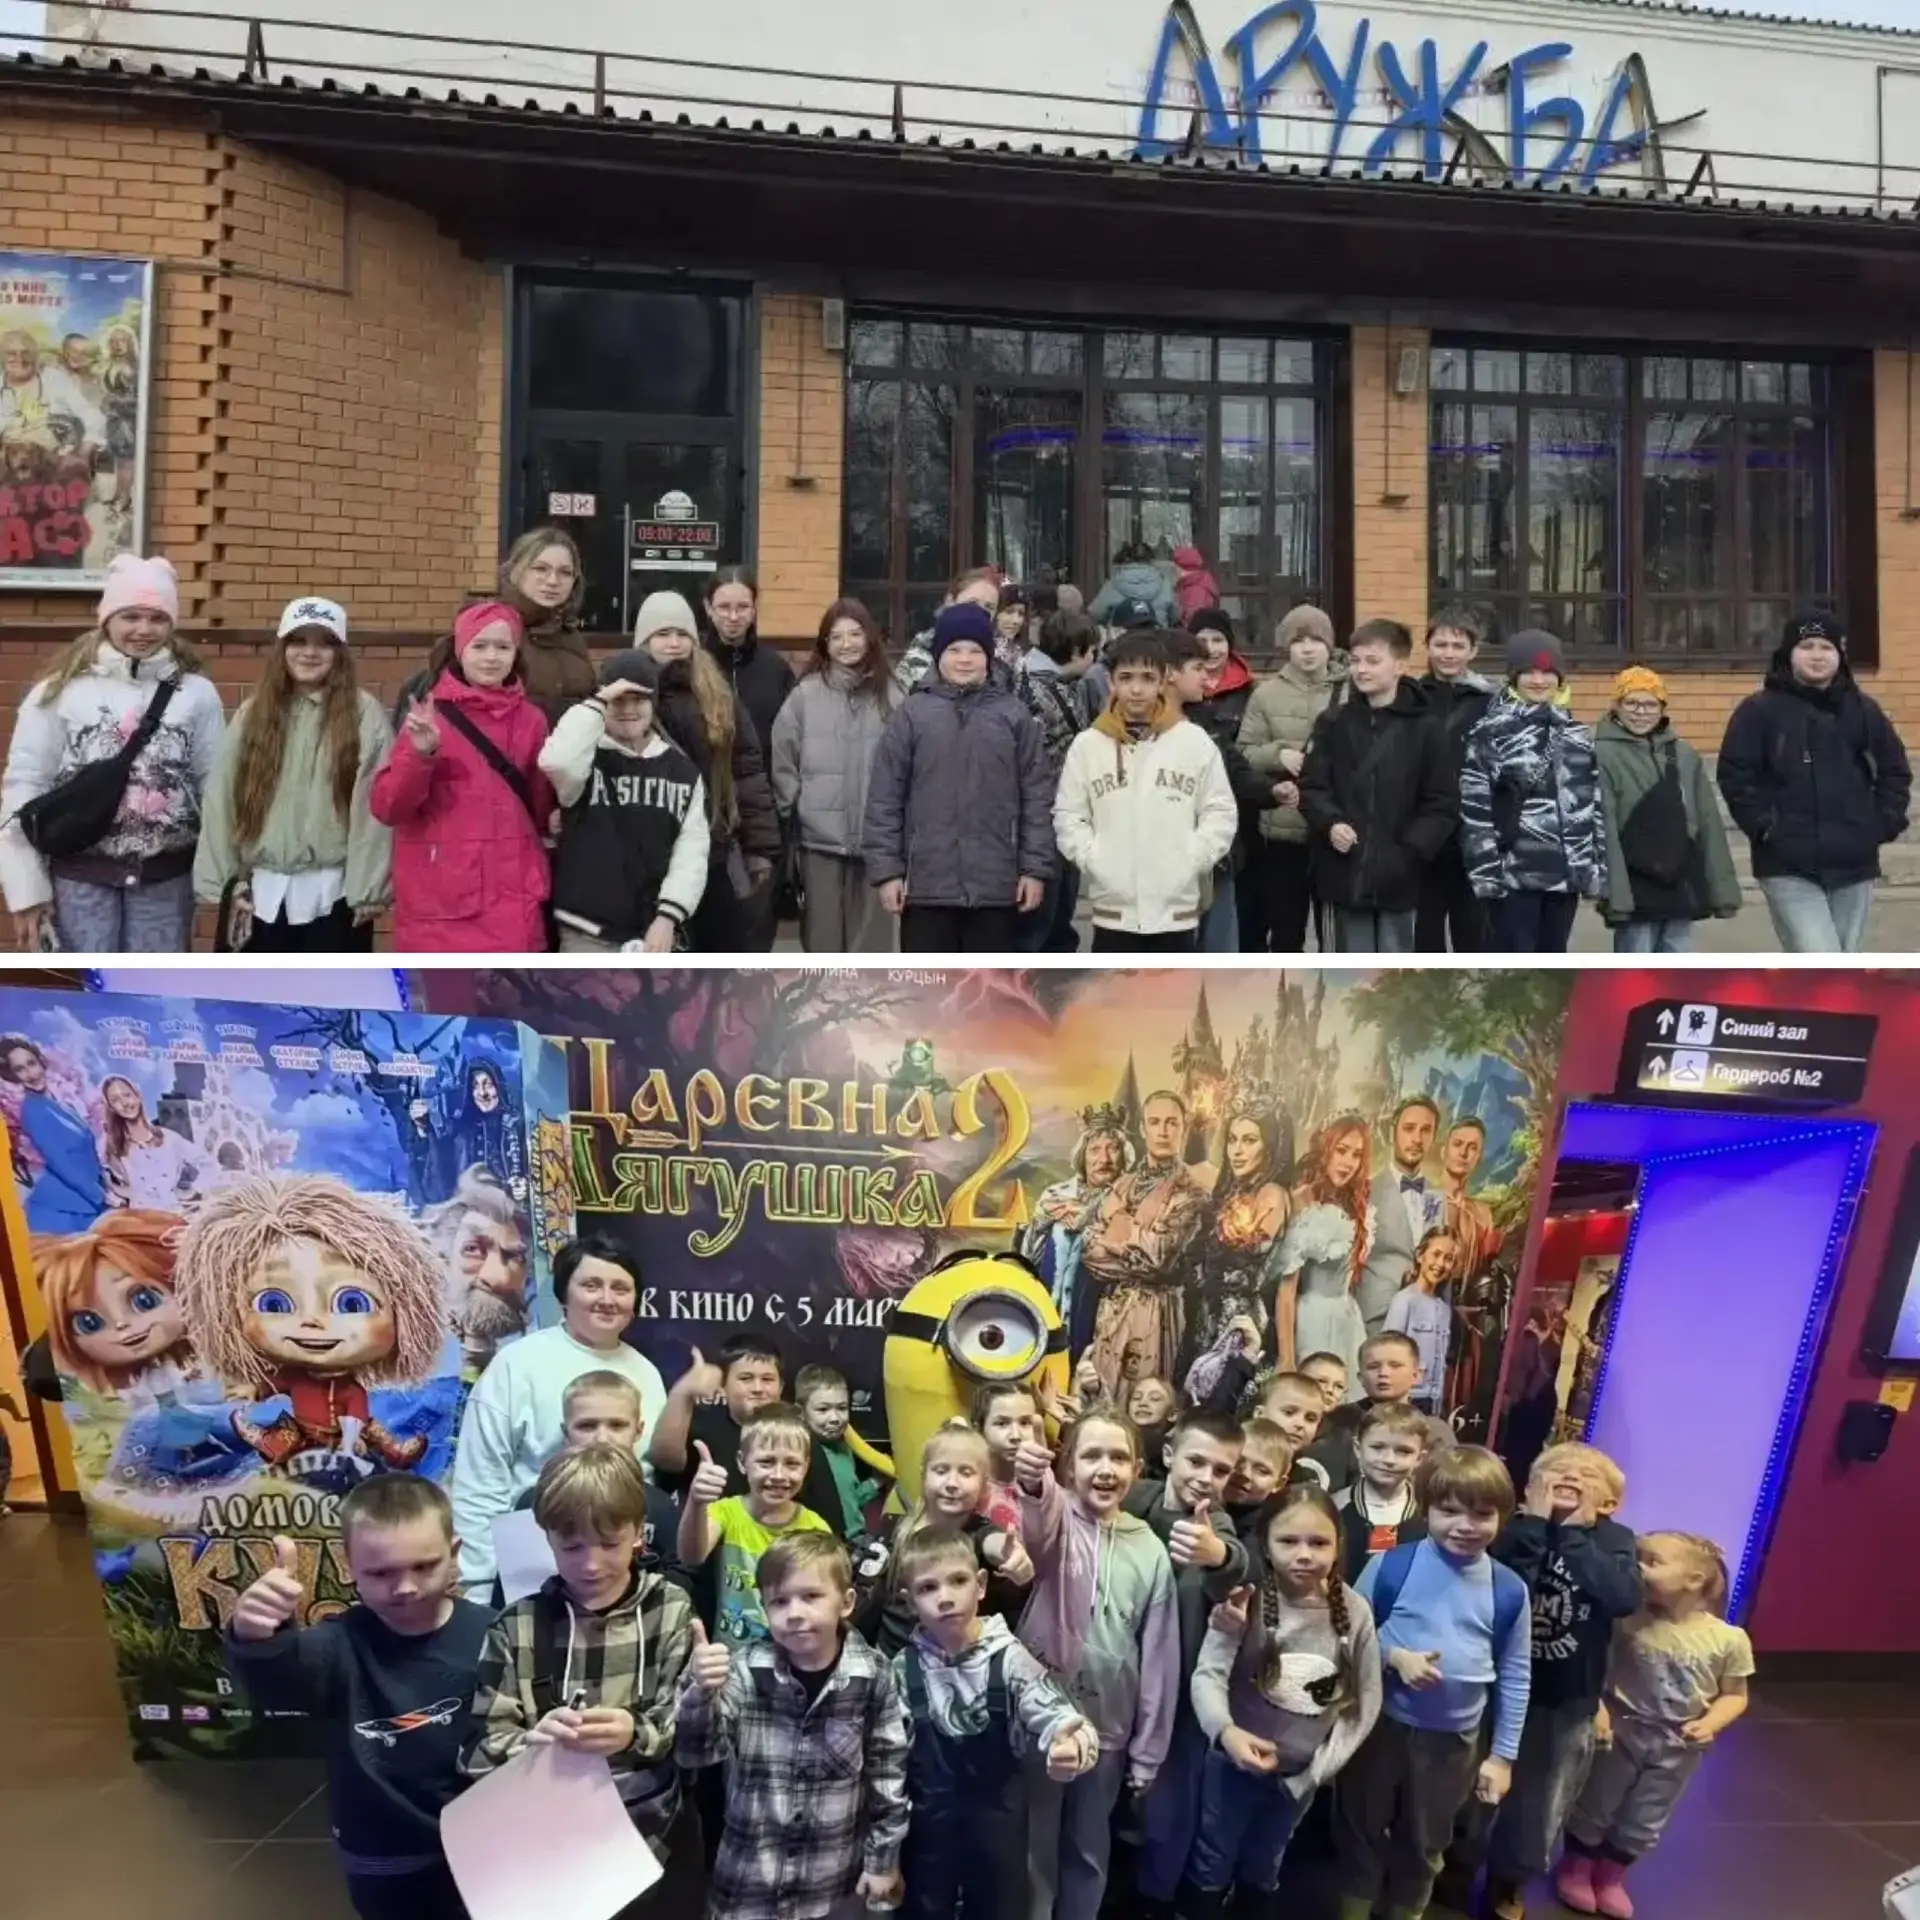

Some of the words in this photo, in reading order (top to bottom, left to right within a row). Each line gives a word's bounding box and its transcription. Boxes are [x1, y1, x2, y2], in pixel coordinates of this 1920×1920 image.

[1132, 0, 1707, 193] ДРУЖБА
[888, 969, 946, 986] КУРЦЫН
[1721, 1018, 1775, 1038] Синий
[1777, 1026, 1808, 1041] зал
[1713, 1063, 1792, 1085] Гардероб
[1793, 1070, 1822, 1087] №2
[946, 1067, 1031, 1228] 2
[669, 1290, 753, 1322] КИНО
[797, 1297, 813, 1326] 5
[824, 1298, 900, 1327] МАР
[1447, 1404, 1485, 1434] 6+
[201, 1494, 343, 1536] ДОМОВ
